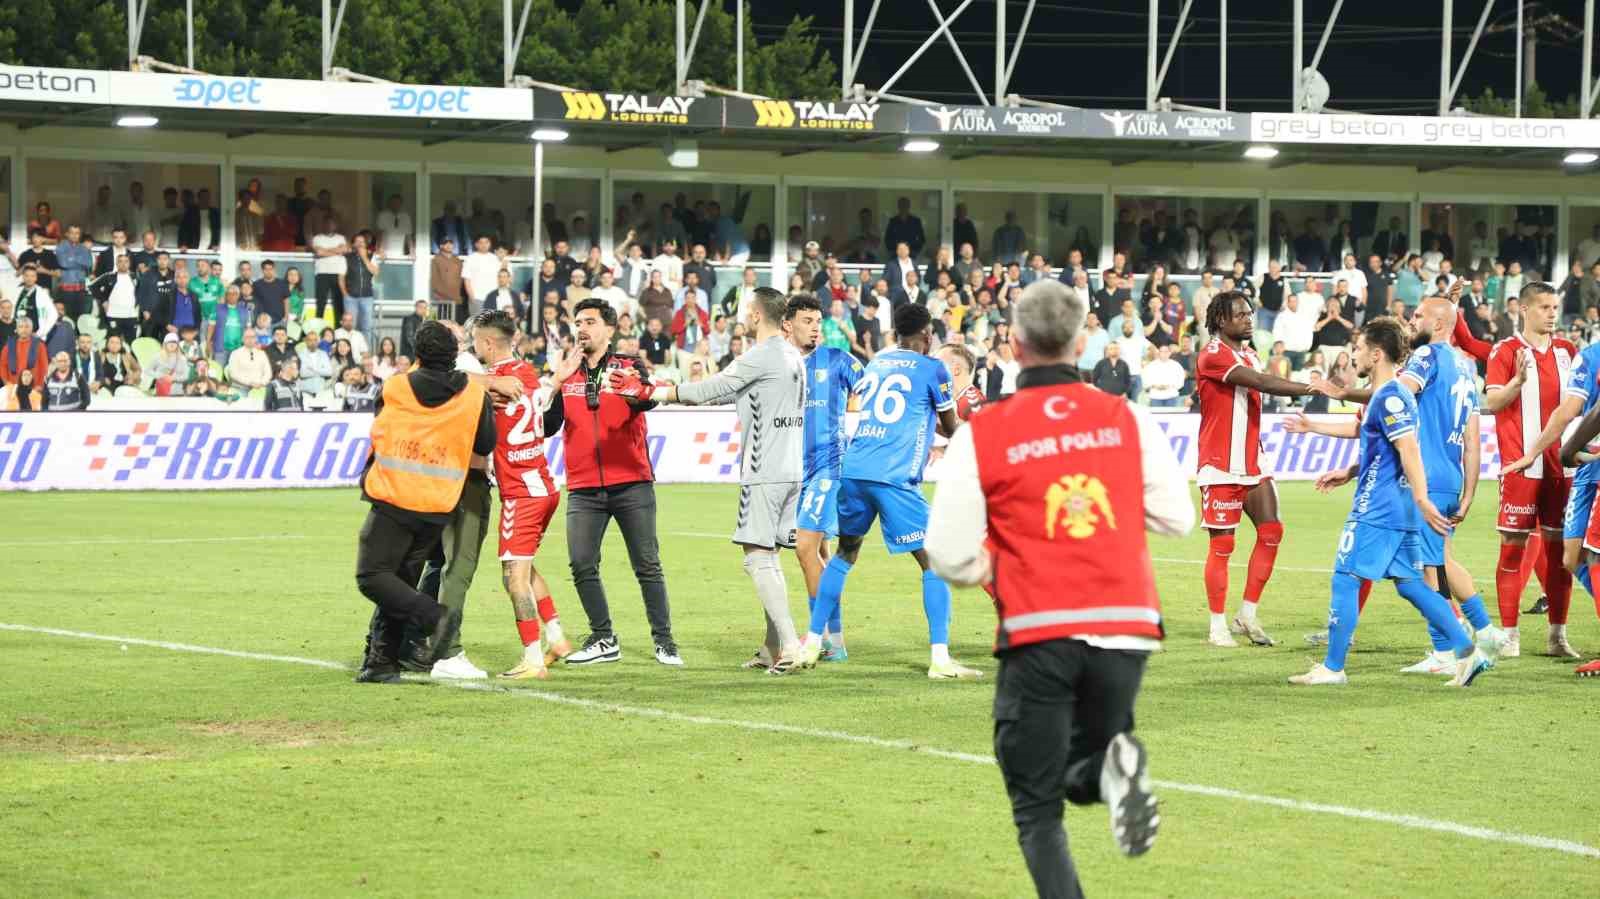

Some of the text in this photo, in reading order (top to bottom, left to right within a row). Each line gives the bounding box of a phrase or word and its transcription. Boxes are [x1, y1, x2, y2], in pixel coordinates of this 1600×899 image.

[174, 78, 262, 106] opet
[387, 86, 470, 114] opet
[605, 93, 696, 114] TALAY
[794, 101, 881, 121] TALAY
[611, 112, 689, 124] LOGISTICS
[800, 119, 874, 129] LOGISTICS
[953, 116, 997, 132] AURA
[1003, 111, 1066, 126] ACROPOL
[1175, 115, 1235, 131] ACROPOL
[1126, 121, 1168, 136] AURA
[1260, 118, 1405, 139] grey beton
[1423, 122, 1566, 142] grey beton
[164, 422, 372, 480] Rent Go
[1006, 436, 1059, 465] SPOR
